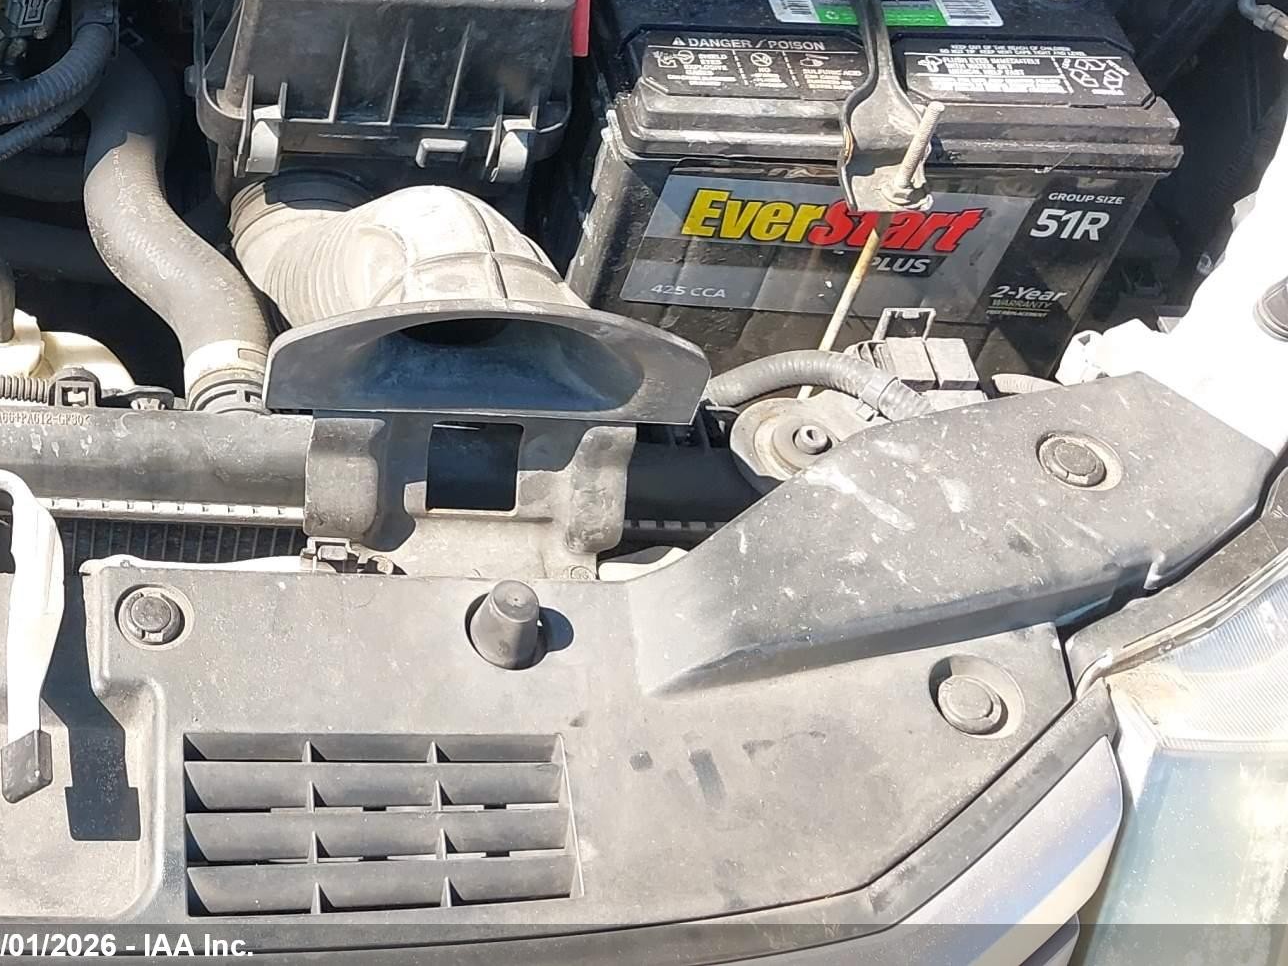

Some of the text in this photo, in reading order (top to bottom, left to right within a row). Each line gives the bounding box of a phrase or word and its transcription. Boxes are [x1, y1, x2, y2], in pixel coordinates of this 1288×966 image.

[687, 37, 752, 49] DANGER
[767, 40, 825, 51] POISON
[1048, 192, 1126, 205] GROUP SIZE
[680, 187, 987, 253] EverStart
[1029, 208, 1110, 242] 51R
[650, 283, 727, 299] 425 CCA
[990, 285, 1069, 302] 2-Year
[991, 299, 1053, 310] WARRANTY
